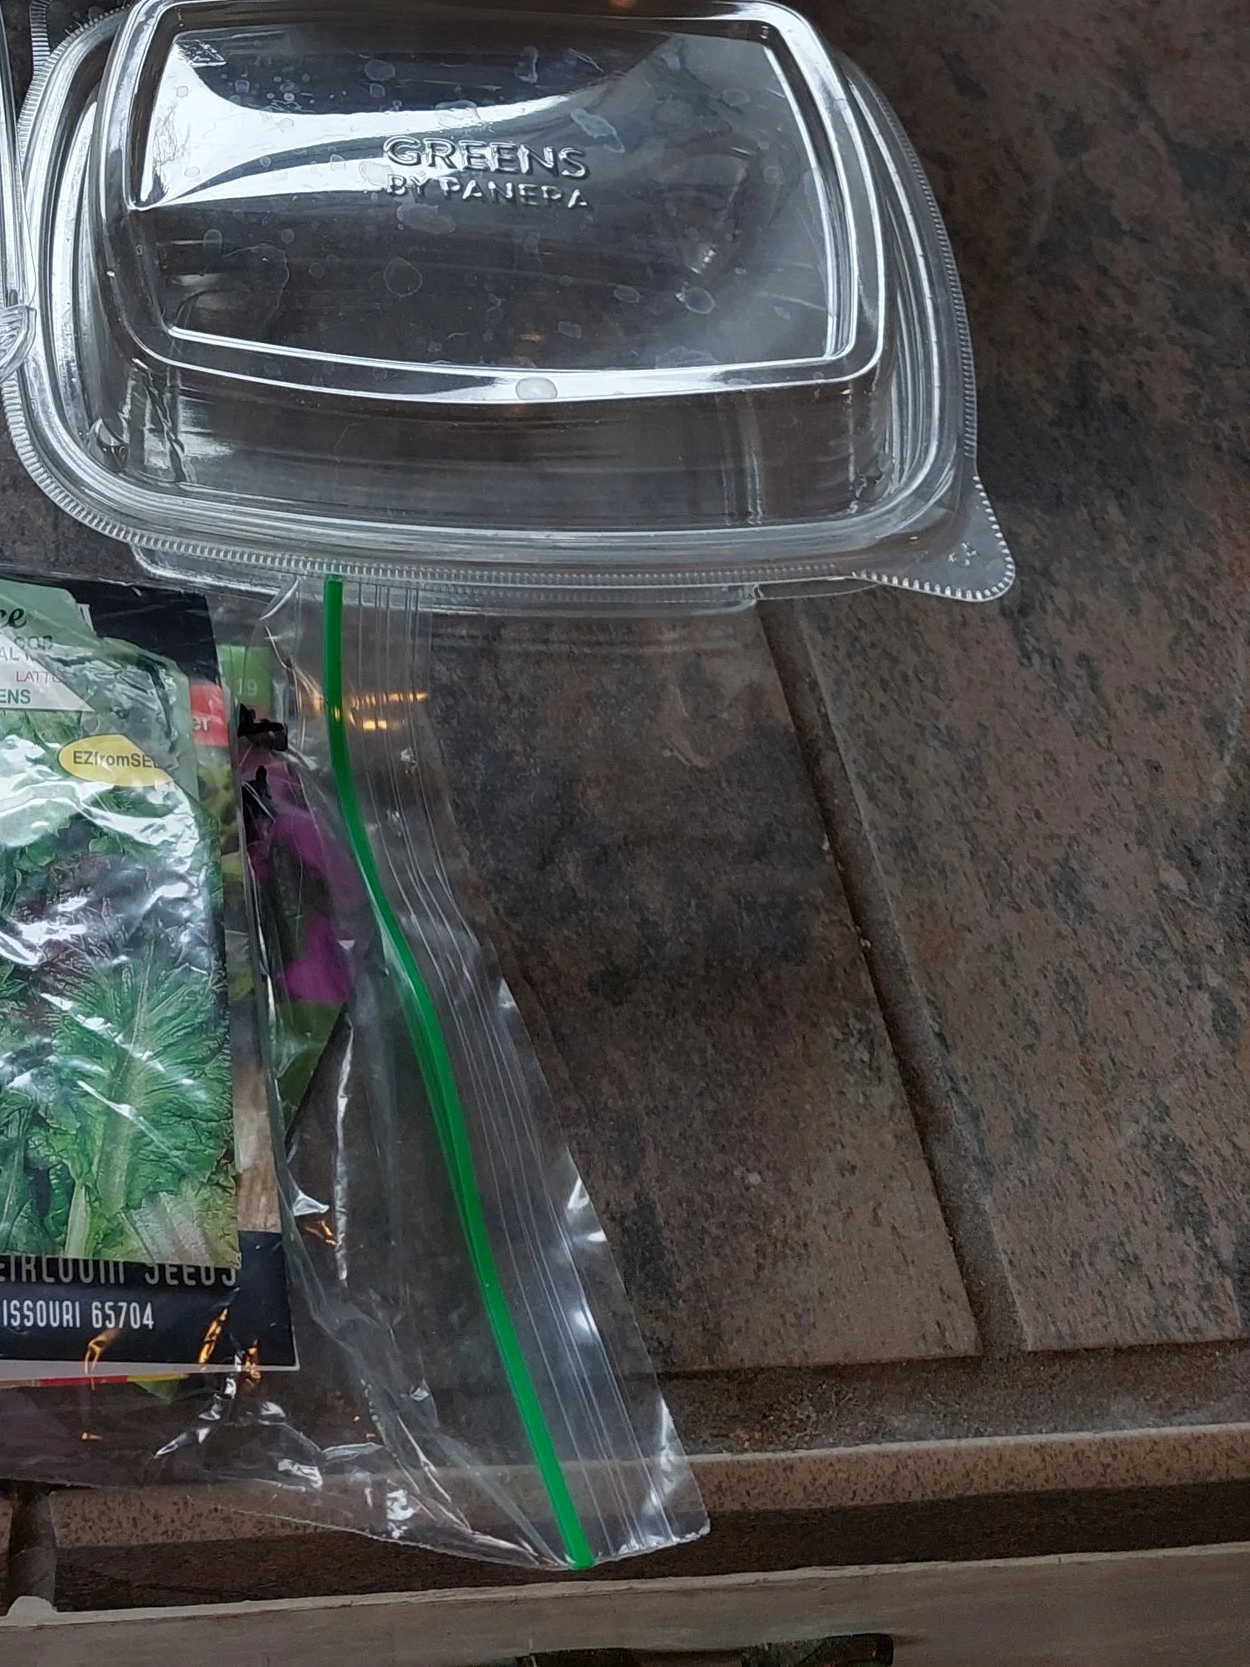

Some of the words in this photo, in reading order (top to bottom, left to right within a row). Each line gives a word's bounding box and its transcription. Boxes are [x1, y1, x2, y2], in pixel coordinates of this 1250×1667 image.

[383, 134, 590, 180] GREENS
[386, 173, 433, 197] BY
[90, 1301, 155, 1330] 65704
